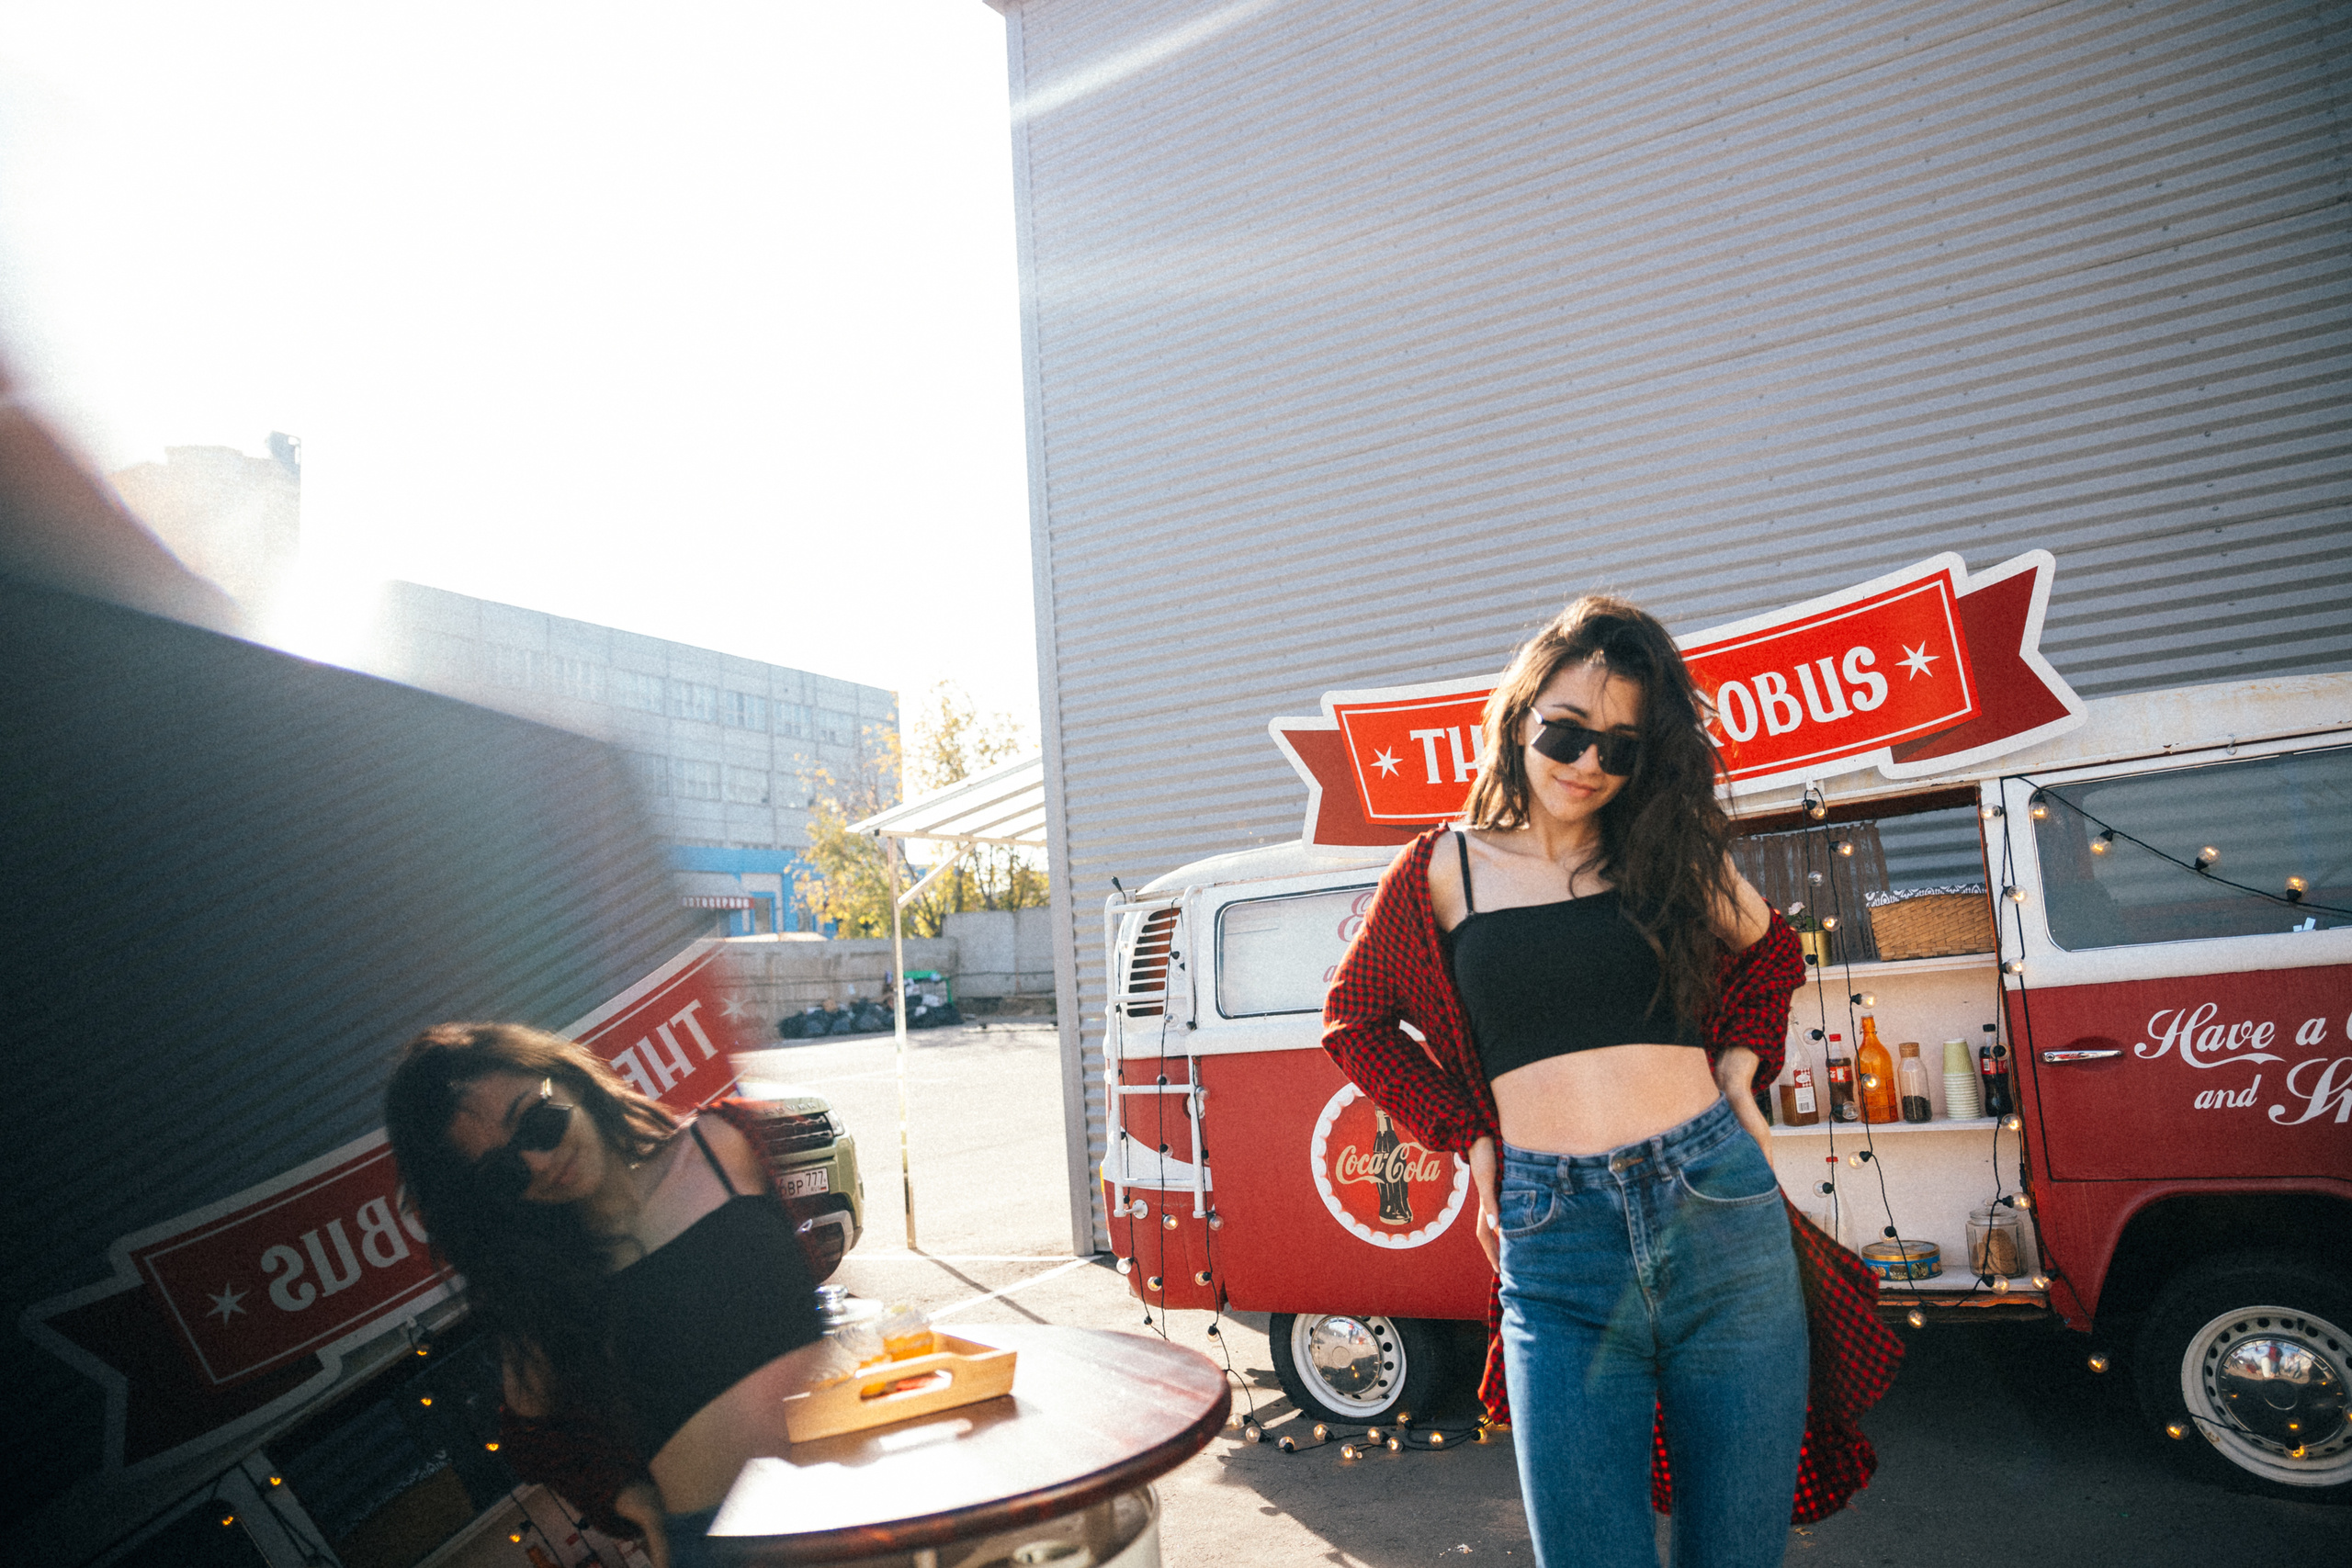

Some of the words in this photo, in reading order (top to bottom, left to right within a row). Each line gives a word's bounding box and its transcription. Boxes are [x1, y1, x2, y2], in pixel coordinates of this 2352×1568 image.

[2133, 1002, 2287, 1069] Have
[2295, 1017, 2327, 1046] a
[763, 1103, 817, 1115] ROVER
[2194, 1074, 2262, 1110] and
[806, 1170, 823, 1187] 777
[1335, 1142, 1442, 1185] Coca-Cola
